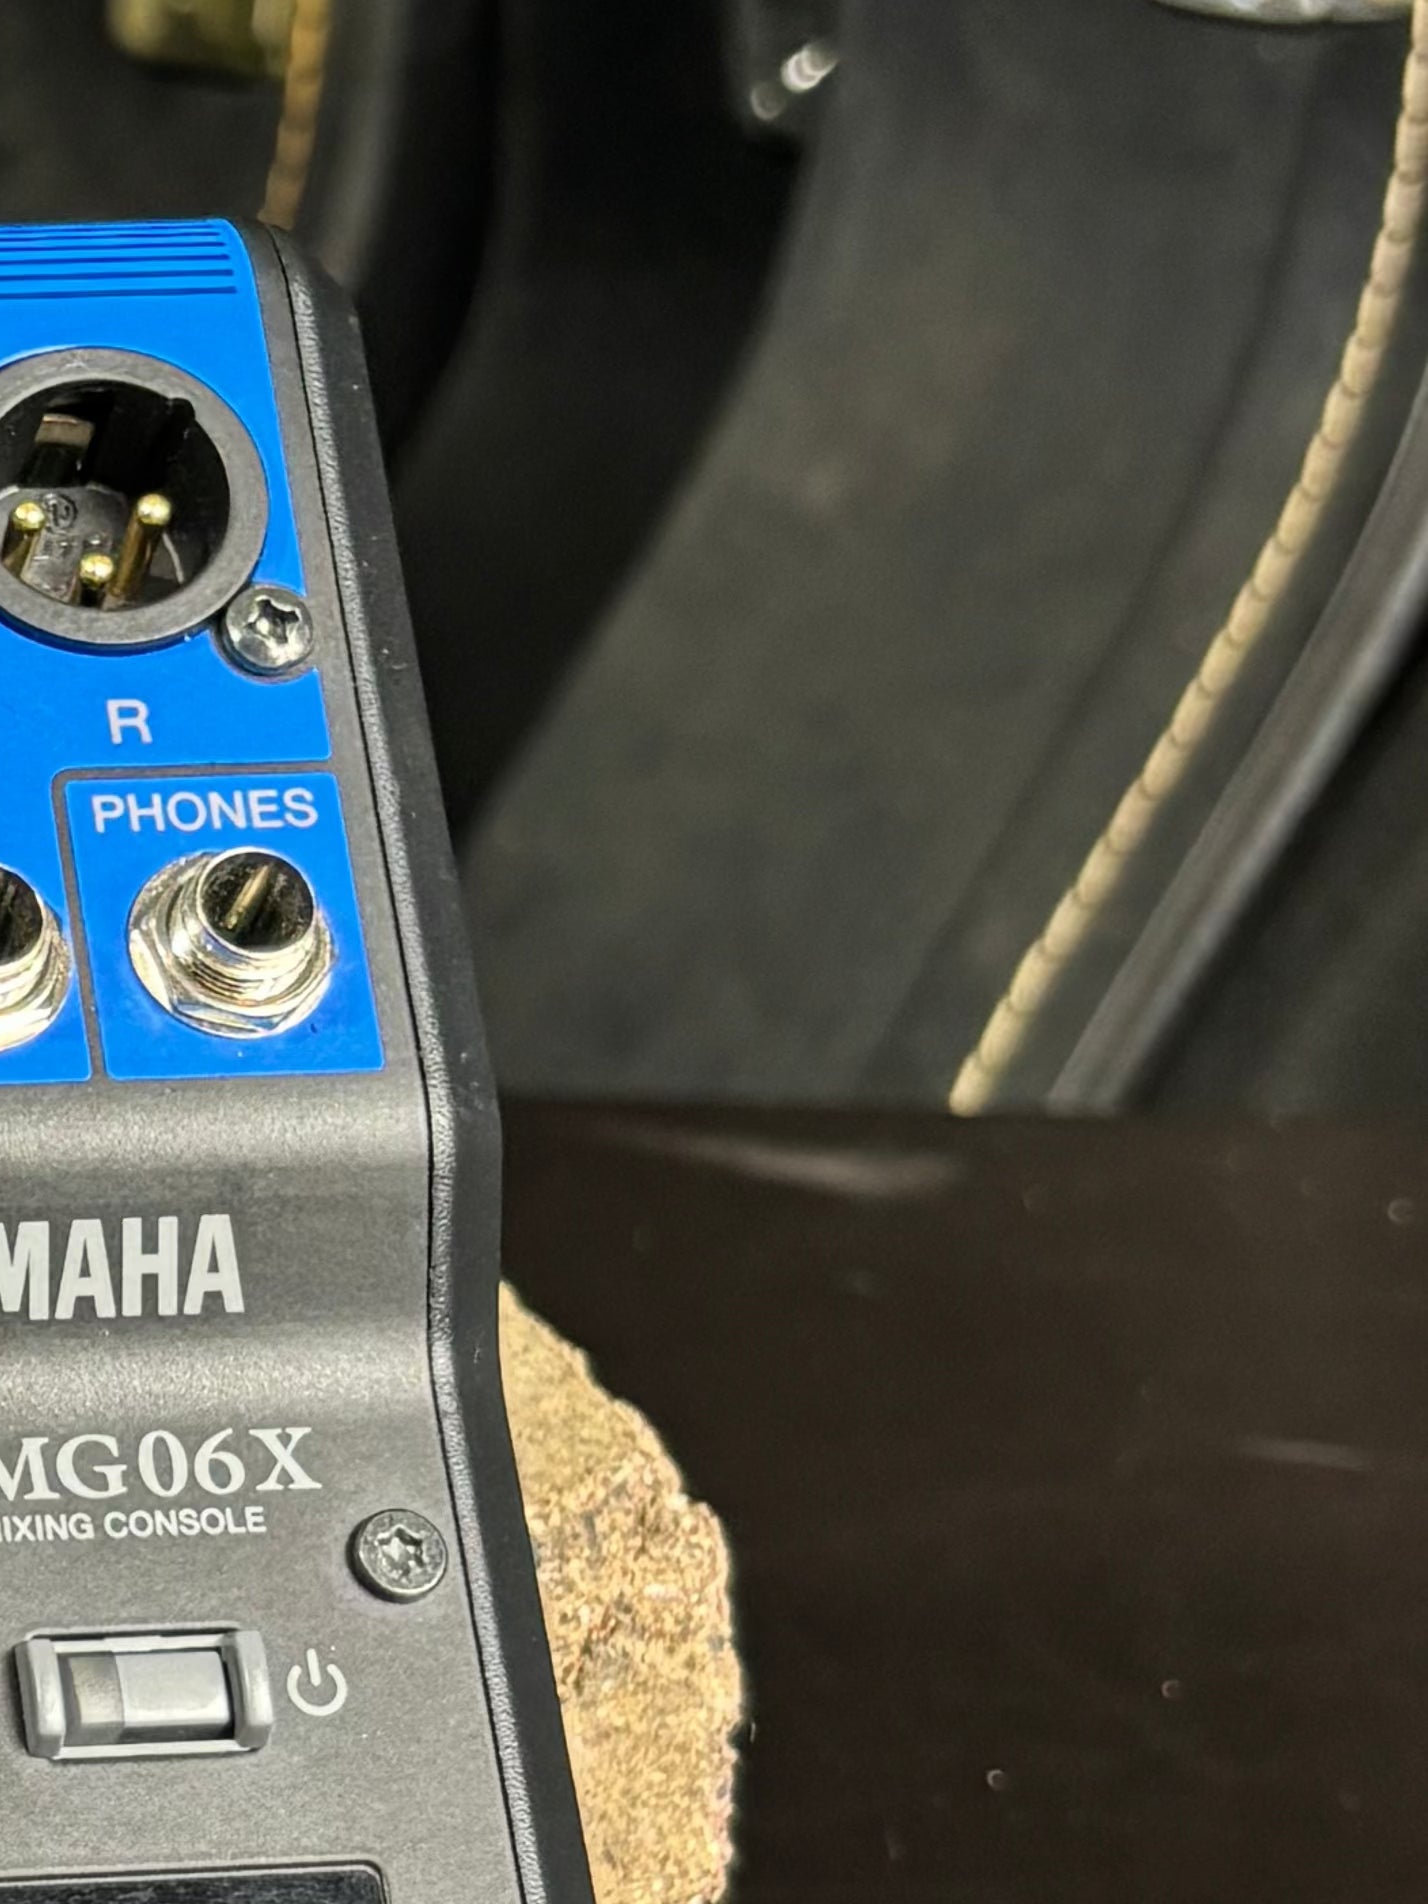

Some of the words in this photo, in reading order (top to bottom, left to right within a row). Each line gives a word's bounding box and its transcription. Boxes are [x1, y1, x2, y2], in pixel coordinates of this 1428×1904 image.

[106, 698, 153, 745] R
[91, 787, 319, 833] PHONES
[103, 1505, 268, 1539] CONSOLE
